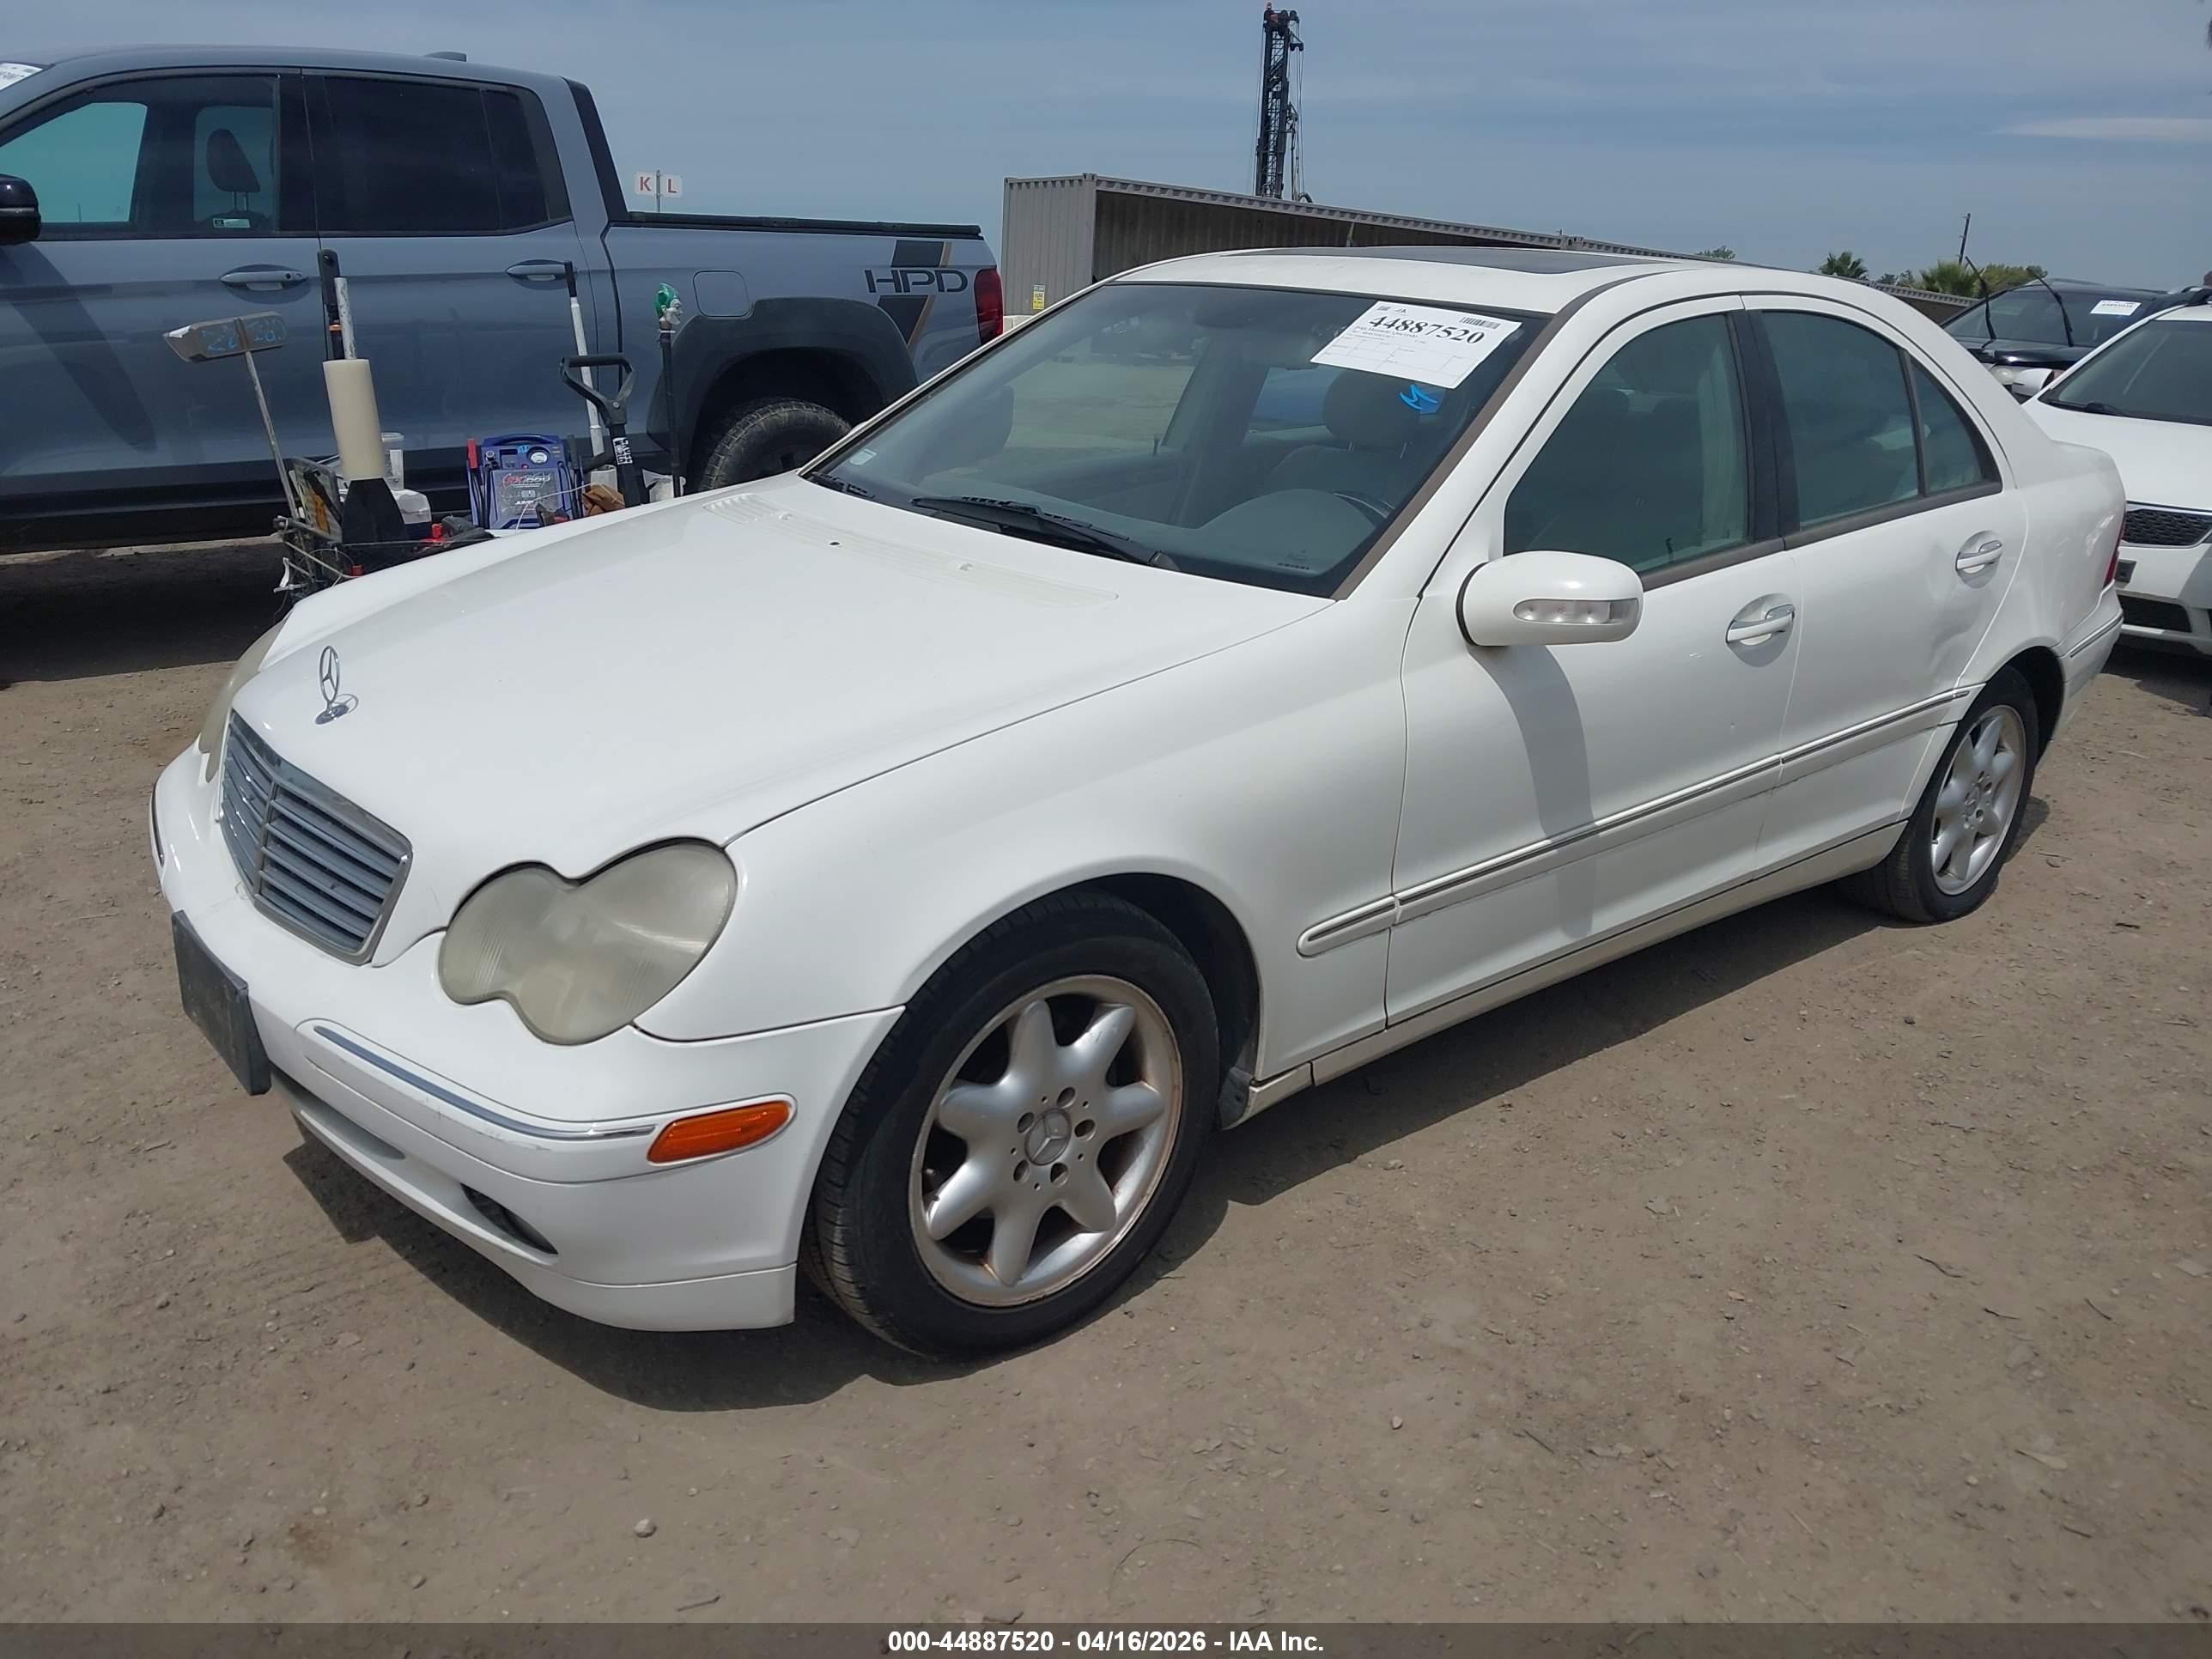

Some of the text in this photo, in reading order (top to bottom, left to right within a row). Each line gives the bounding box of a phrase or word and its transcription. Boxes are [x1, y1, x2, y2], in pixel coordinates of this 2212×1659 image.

[640, 176, 652, 191] K
[667, 178, 678, 193] L
[865, 270, 968, 294] HPD
[1369, 315, 1485, 344] 44887520
